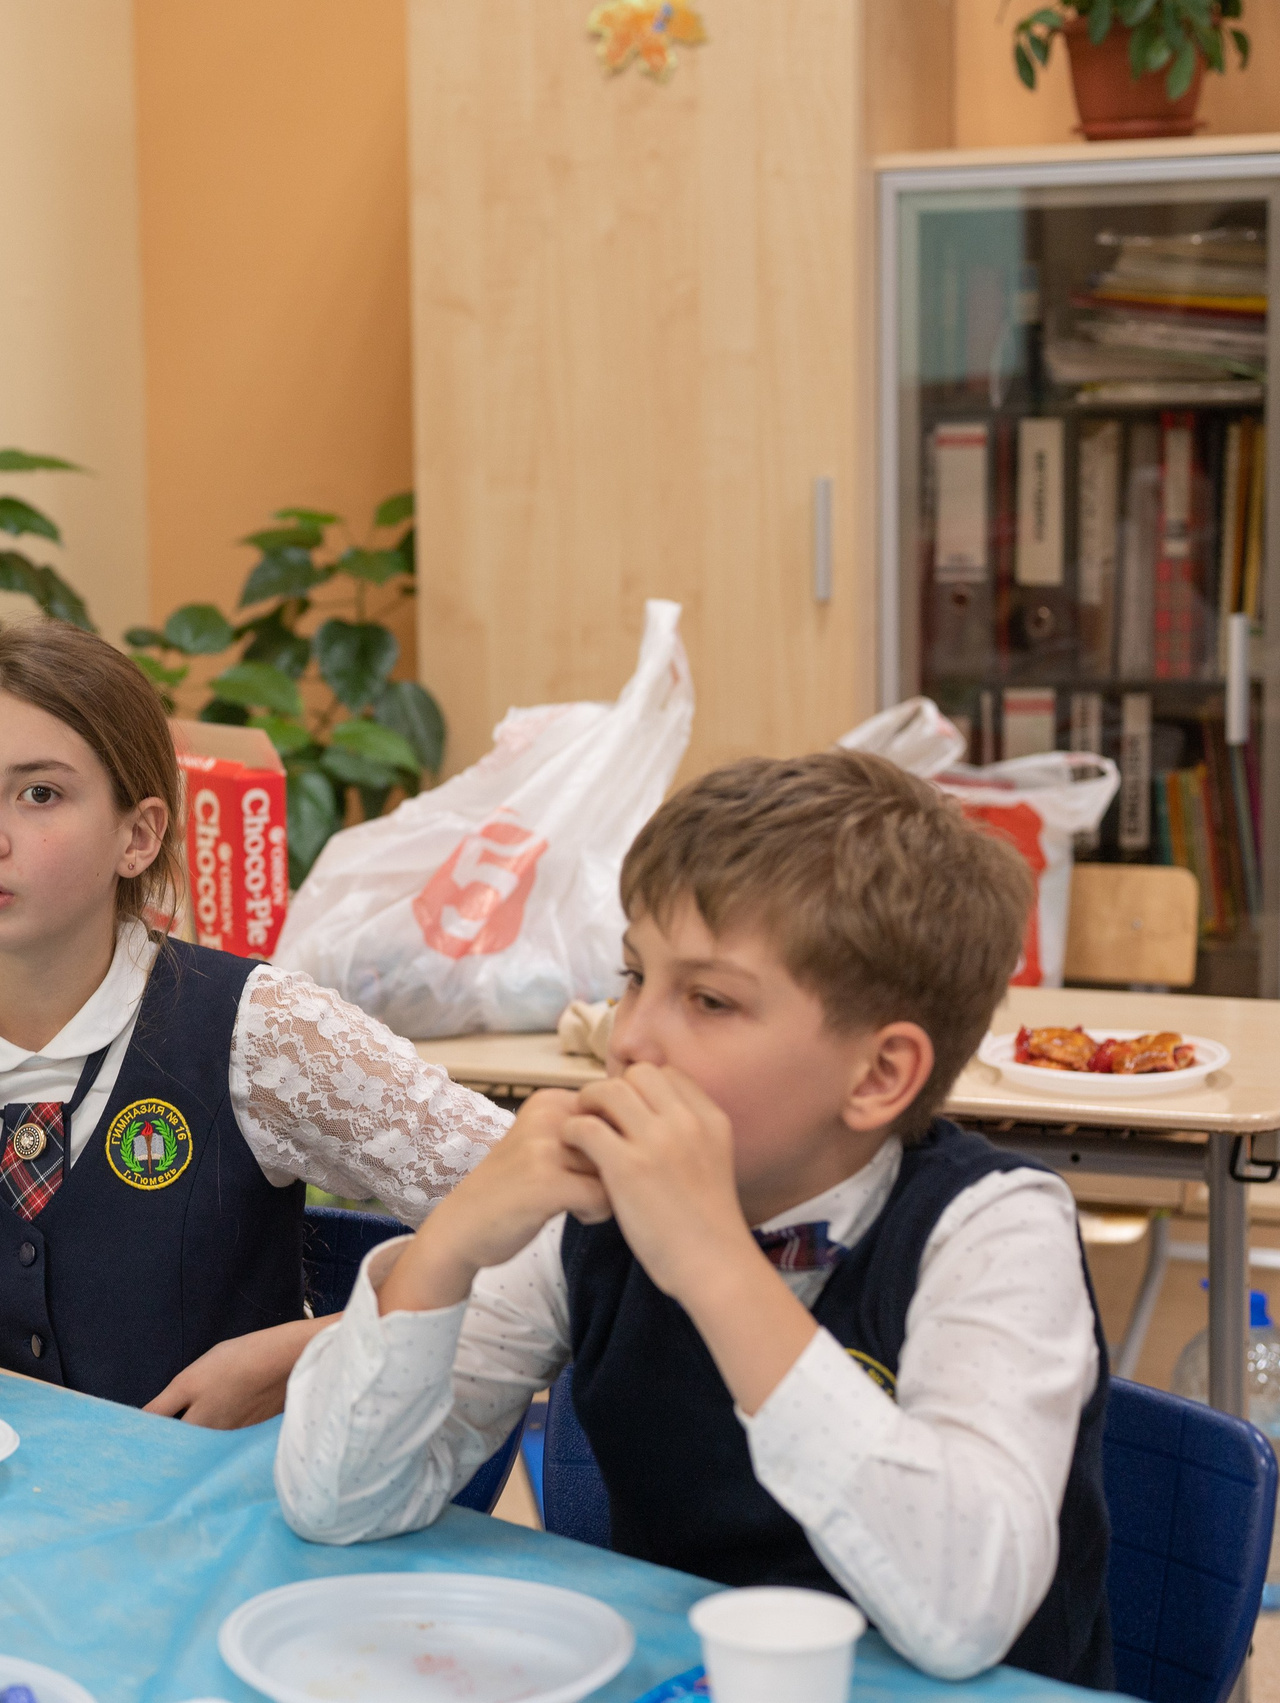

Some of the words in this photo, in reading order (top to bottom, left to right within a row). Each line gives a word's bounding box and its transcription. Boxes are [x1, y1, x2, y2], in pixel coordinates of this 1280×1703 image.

[111, 1104, 165, 1145] ГИМНАЗИЯ
[166, 1111, 179, 1126] №
[175, 1126, 187, 1141] 16
[133, 1168, 177, 1186] Тюмень
